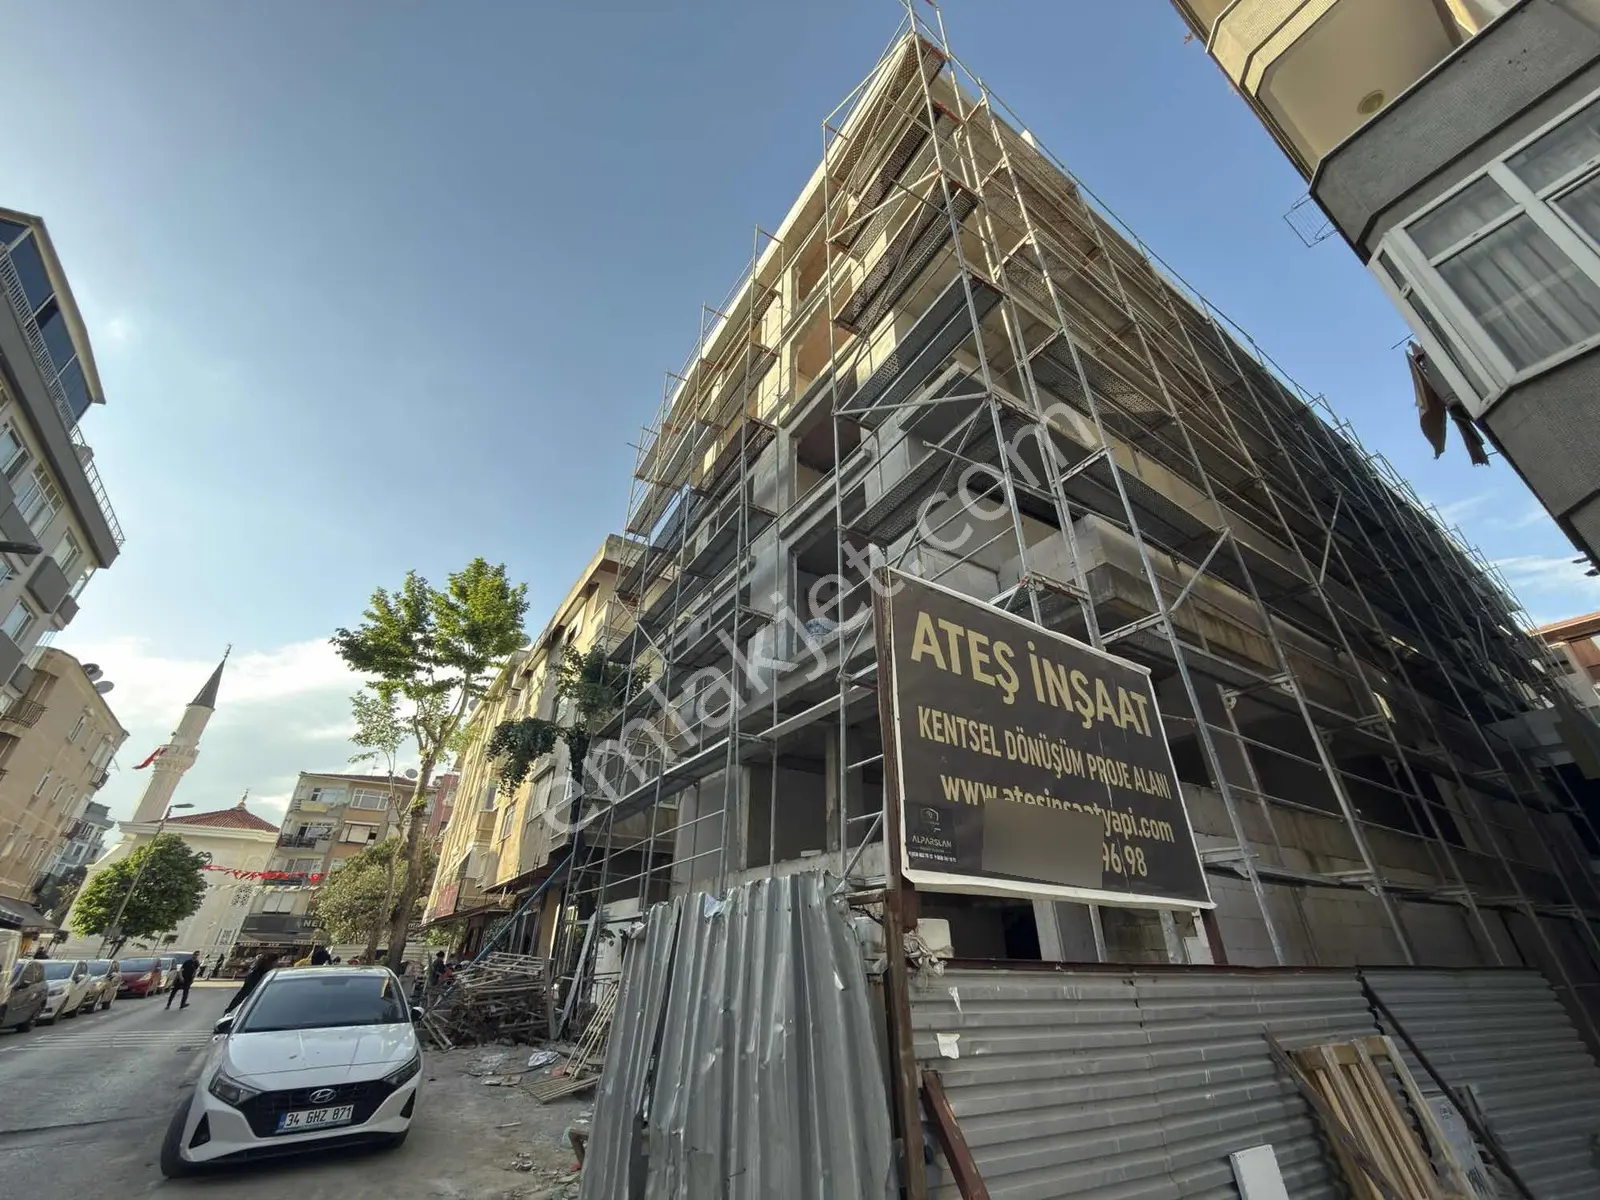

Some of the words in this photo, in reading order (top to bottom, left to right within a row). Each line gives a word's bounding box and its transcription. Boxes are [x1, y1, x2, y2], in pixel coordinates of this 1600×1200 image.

[911, 611, 1020, 705] ATEŞ
[1028, 641, 1152, 737] İNŞAAT
[918, 706, 1002, 757] KENTSEL
[1005, 726, 1086, 779] DÖNÜŞÜM
[1087, 753, 1133, 792] PROJE
[1134, 770, 1171, 799] ALANI
[940, 774, 1175, 843] wwwatiyapi.com
[1125, 846, 1148, 877] 98
[286, 1113, 300, 1127] 34
[306, 1109, 328, 1124] GHZ
[332, 1106, 352, 1120] 871
